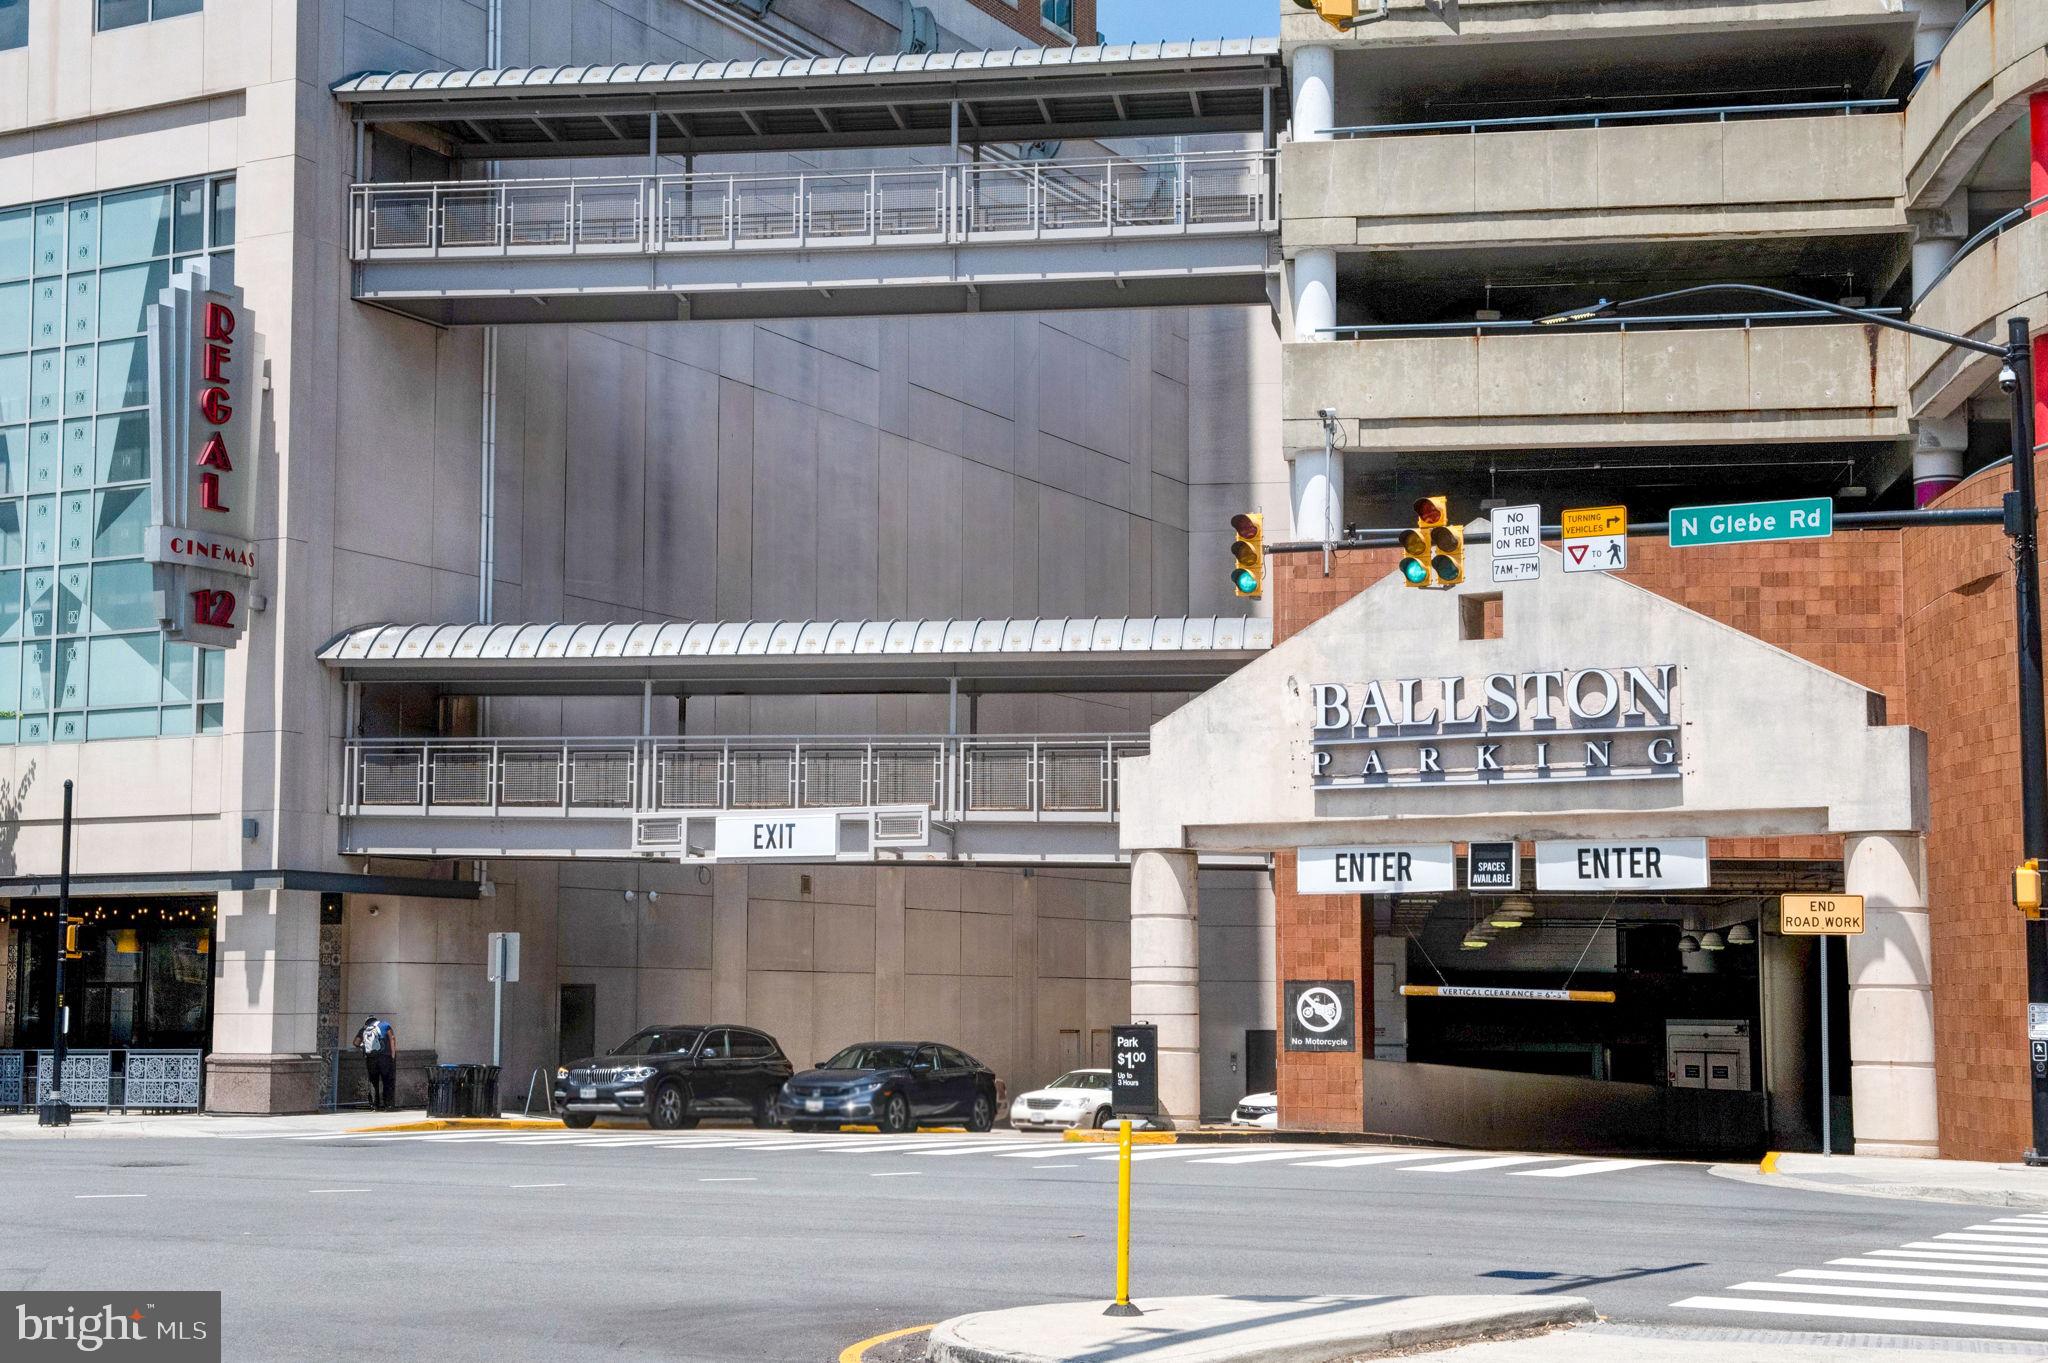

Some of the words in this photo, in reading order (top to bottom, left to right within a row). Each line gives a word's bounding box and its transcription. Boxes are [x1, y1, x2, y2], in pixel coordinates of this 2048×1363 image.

[198, 302, 235, 513] REGAL
[1507, 512, 1524, 524] NO
[1567, 513, 1602, 523] TURNING
[1681, 517, 1698, 537] N
[1709, 513, 1776, 535] Glebe
[1789, 508, 1821, 529] Rd
[1502, 525, 1530, 536] TURN
[1565, 524, 1604, 534] VEHICLES
[1496, 540, 1511, 550] ON
[1515, 537, 1536, 548] RED
[170, 537, 255, 568] CINEMAS
[1592, 550, 1602, 558] TO
[189, 588, 235, 629] 12
[1310, 664, 1676, 730] BALLSTON
[1312, 738, 1677, 776] PARKING
[753, 823, 796, 850] EXIT
[1335, 851, 1412, 883] ENTER
[1478, 861, 1506, 872] SPACES
[1577, 846, 1662, 879] ENTER
[1472, 873, 1511, 883] AVAILABLE
[1810, 901, 1836, 912] END
[1785, 916, 1820, 928] ROAD
[1824, 917, 1860, 928] WORK
[1442, 987, 1482, 997] VERTICAL
[1484, 989, 1534, 998] CLEARANCE
[1117, 1036, 1139, 1048] Park
[1291, 1037, 1303, 1045] No
[1305, 1037, 1348, 1047] Motorcycle
[1117, 1072, 1126, 1080] Up
